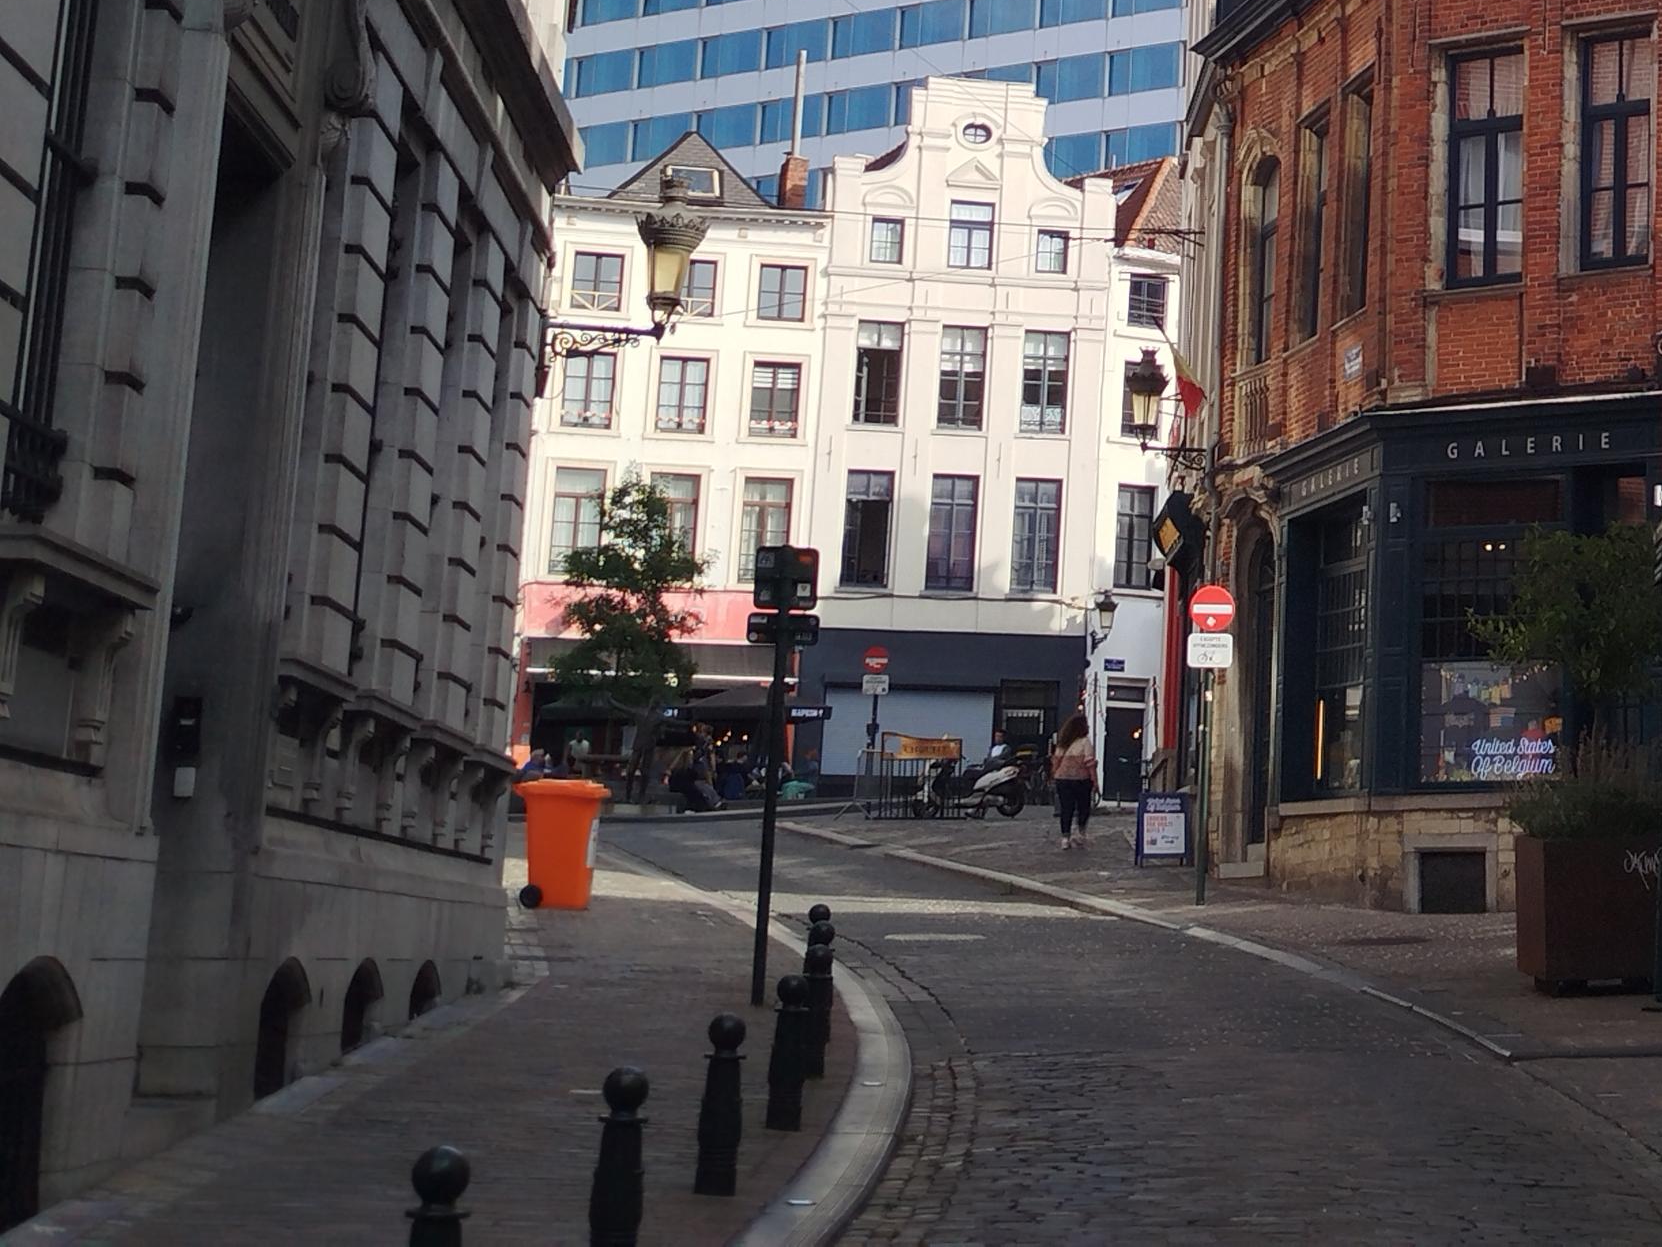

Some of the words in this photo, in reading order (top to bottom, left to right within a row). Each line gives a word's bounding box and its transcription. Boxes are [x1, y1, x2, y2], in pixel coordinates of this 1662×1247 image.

[1446, 431, 1611, 459] GALERIE
[1300, 456, 1360, 497] GALERIE
[1470, 738, 1516, 755] United
[1516, 736, 1556, 755] States
[1470, 755, 1493, 781] Of
[1491, 754, 1556, 781] Belgium
